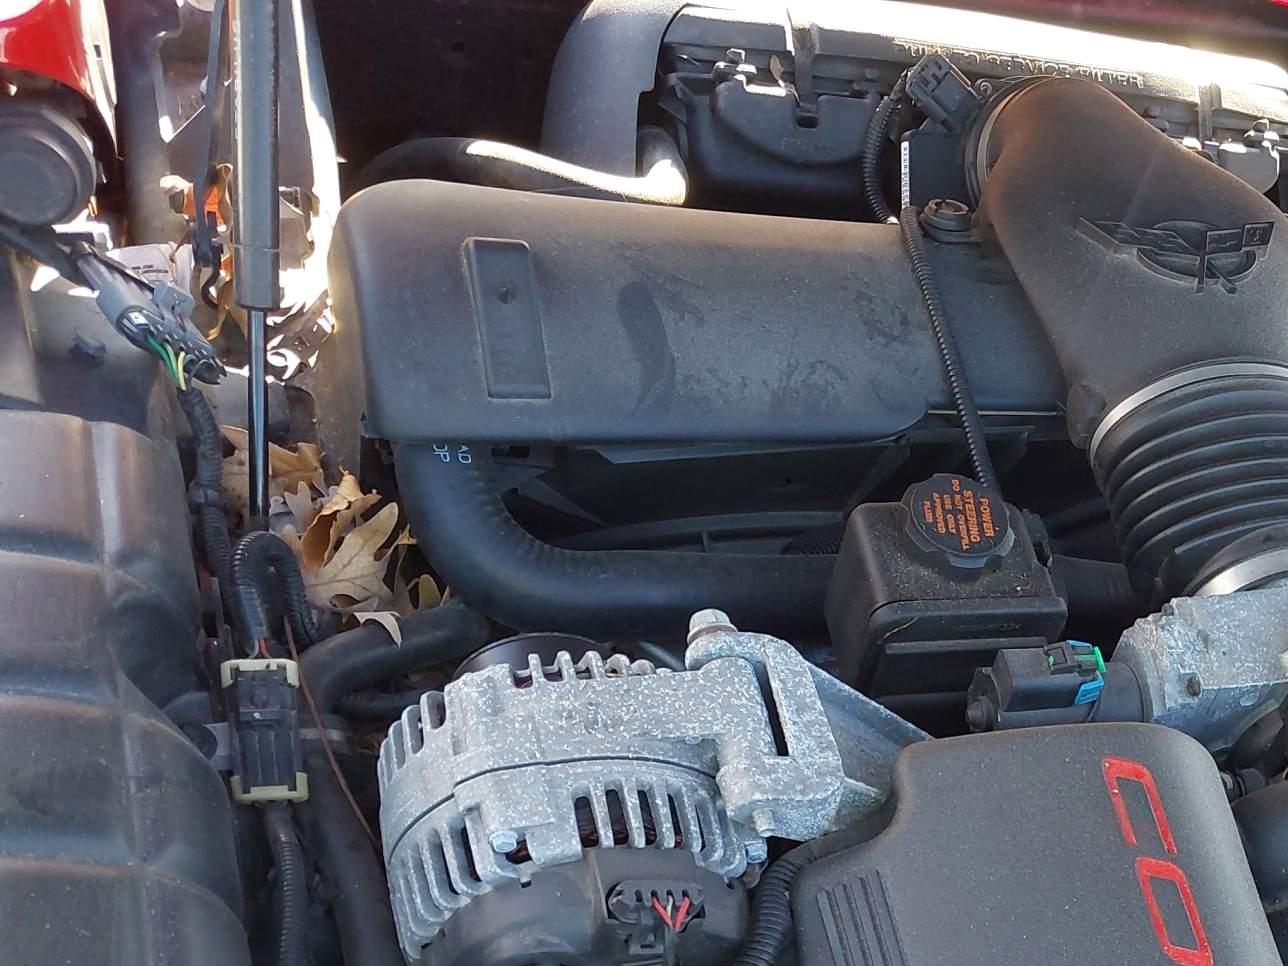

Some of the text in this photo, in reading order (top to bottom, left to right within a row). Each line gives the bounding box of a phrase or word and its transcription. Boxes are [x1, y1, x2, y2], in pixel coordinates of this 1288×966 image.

[923, 500, 934, 523] FLUID
[932, 492, 946, 534] APPROVED
[944, 494, 957, 535] USE ONLY
[951, 480, 971, 551] DO NOT OVERFILL
[963, 490, 981, 543] STEERING
[980, 496, 995, 538] POWER
